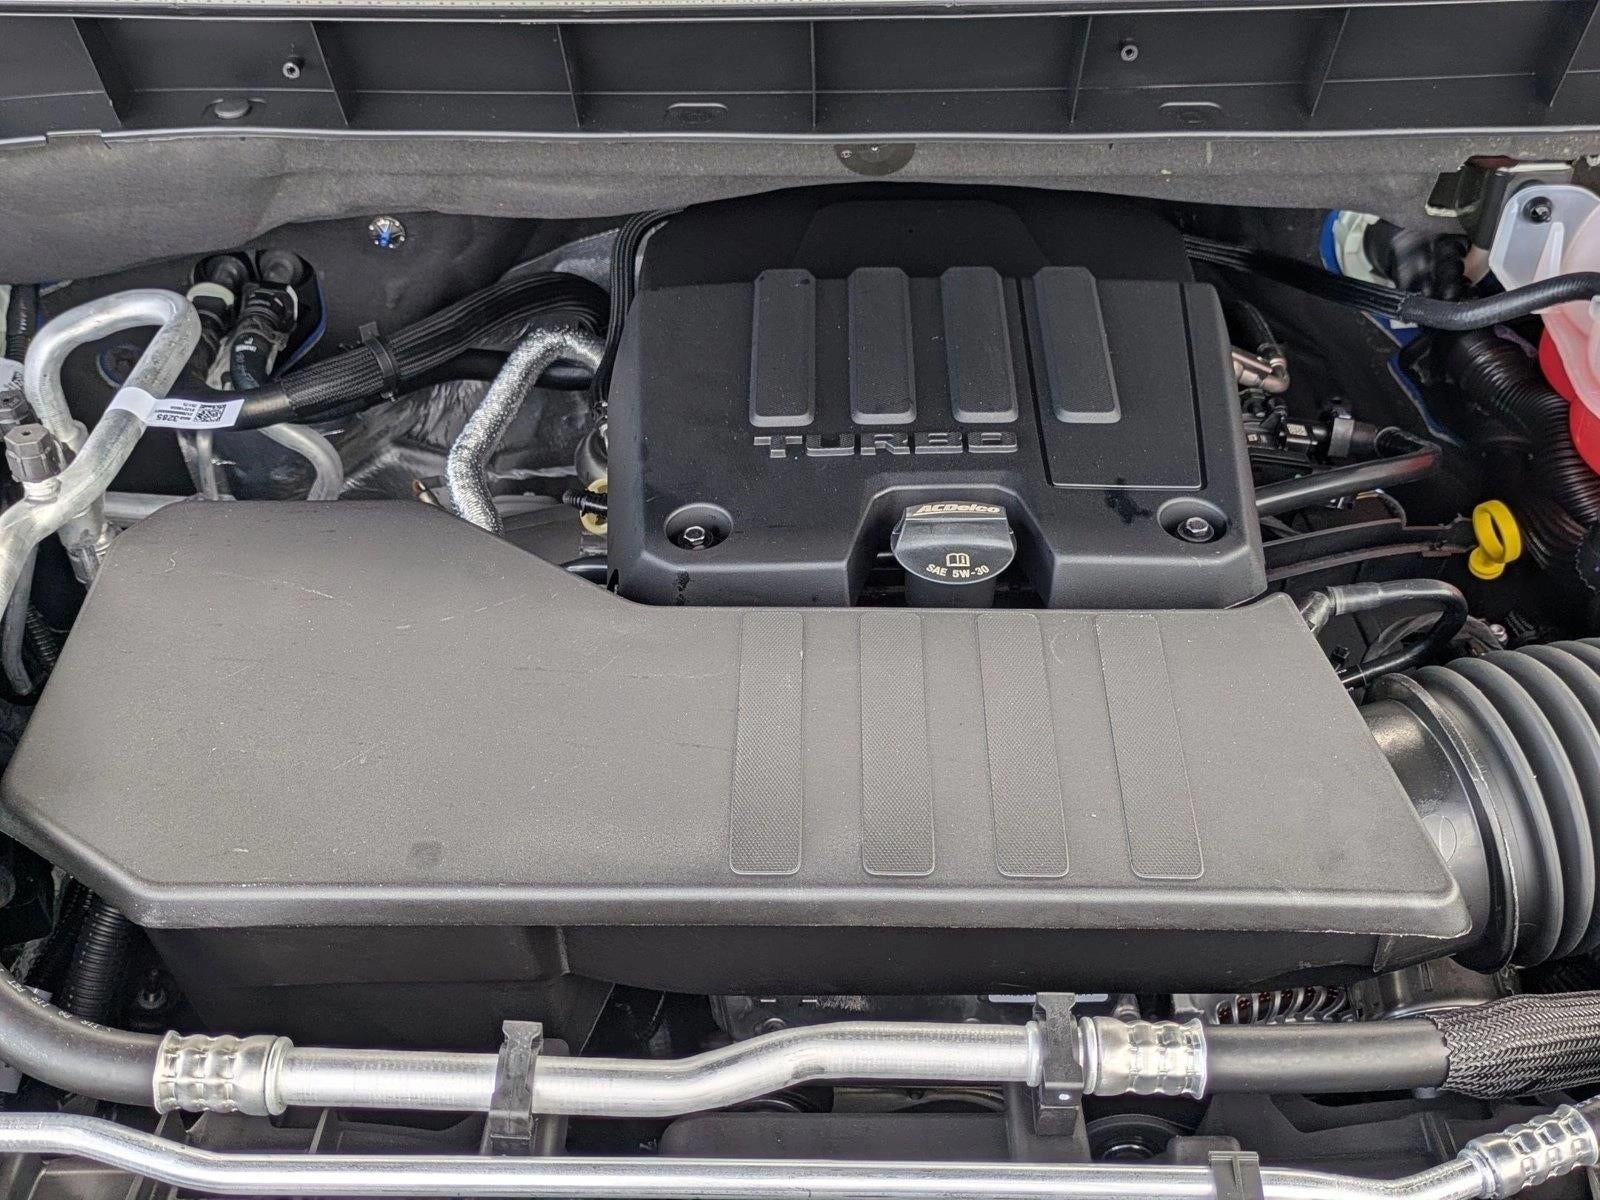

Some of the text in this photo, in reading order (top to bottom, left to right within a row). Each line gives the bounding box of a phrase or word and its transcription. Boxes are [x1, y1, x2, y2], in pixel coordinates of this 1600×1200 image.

[754, 432, 1018, 458] TURBO
[914, 503, 1001, 515] ACDelco
[926, 563, 990, 578] SAE 5W-30
